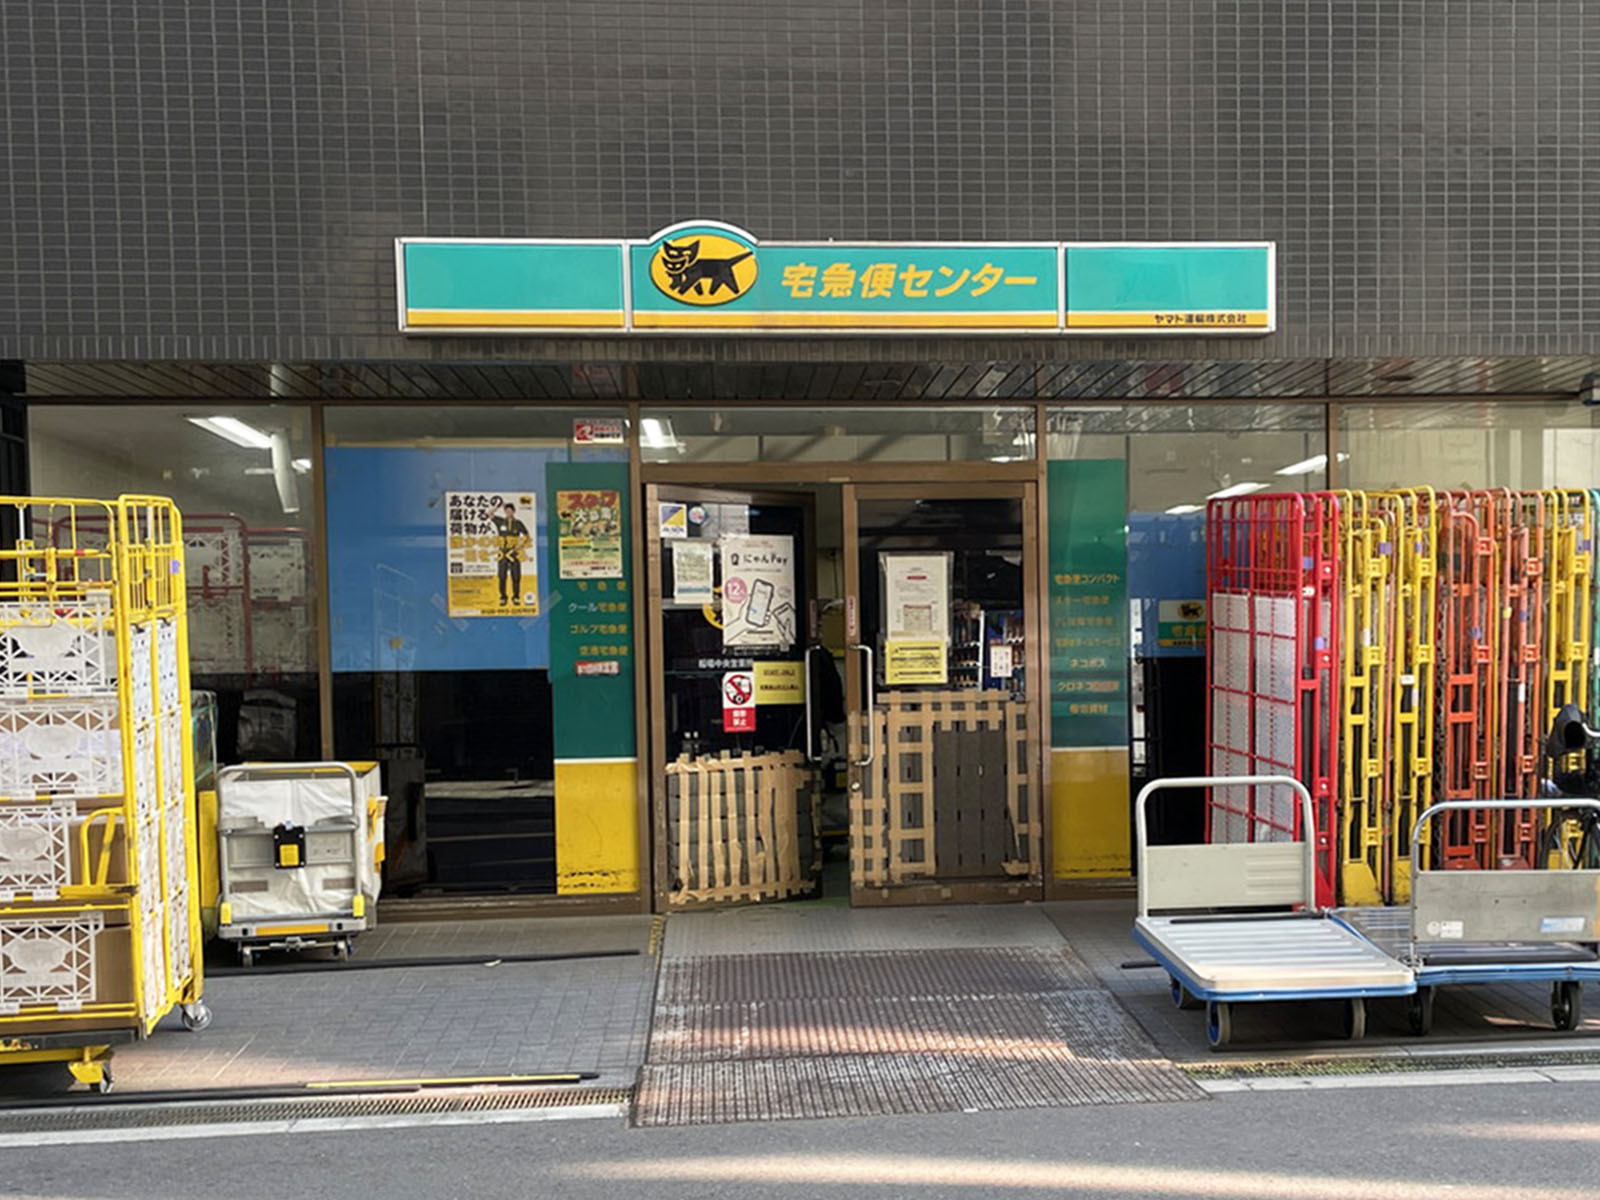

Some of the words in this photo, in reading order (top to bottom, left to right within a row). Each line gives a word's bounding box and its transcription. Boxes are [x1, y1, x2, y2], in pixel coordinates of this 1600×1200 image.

[781, 262, 1038, 299] 宅急便センター
[1155, 313, 1247, 324] ヤマト運輸株式会社
[449, 495, 503, 507] あなたの
[450, 508, 489, 521] 届ける
[450, 522, 496, 535] 荷物が、
[1054, 573, 1120, 584] 宅急便コンパクト
[568, 602, 628, 612] クール宅急便
[570, 624, 628, 634] ゴルフ宅急便
